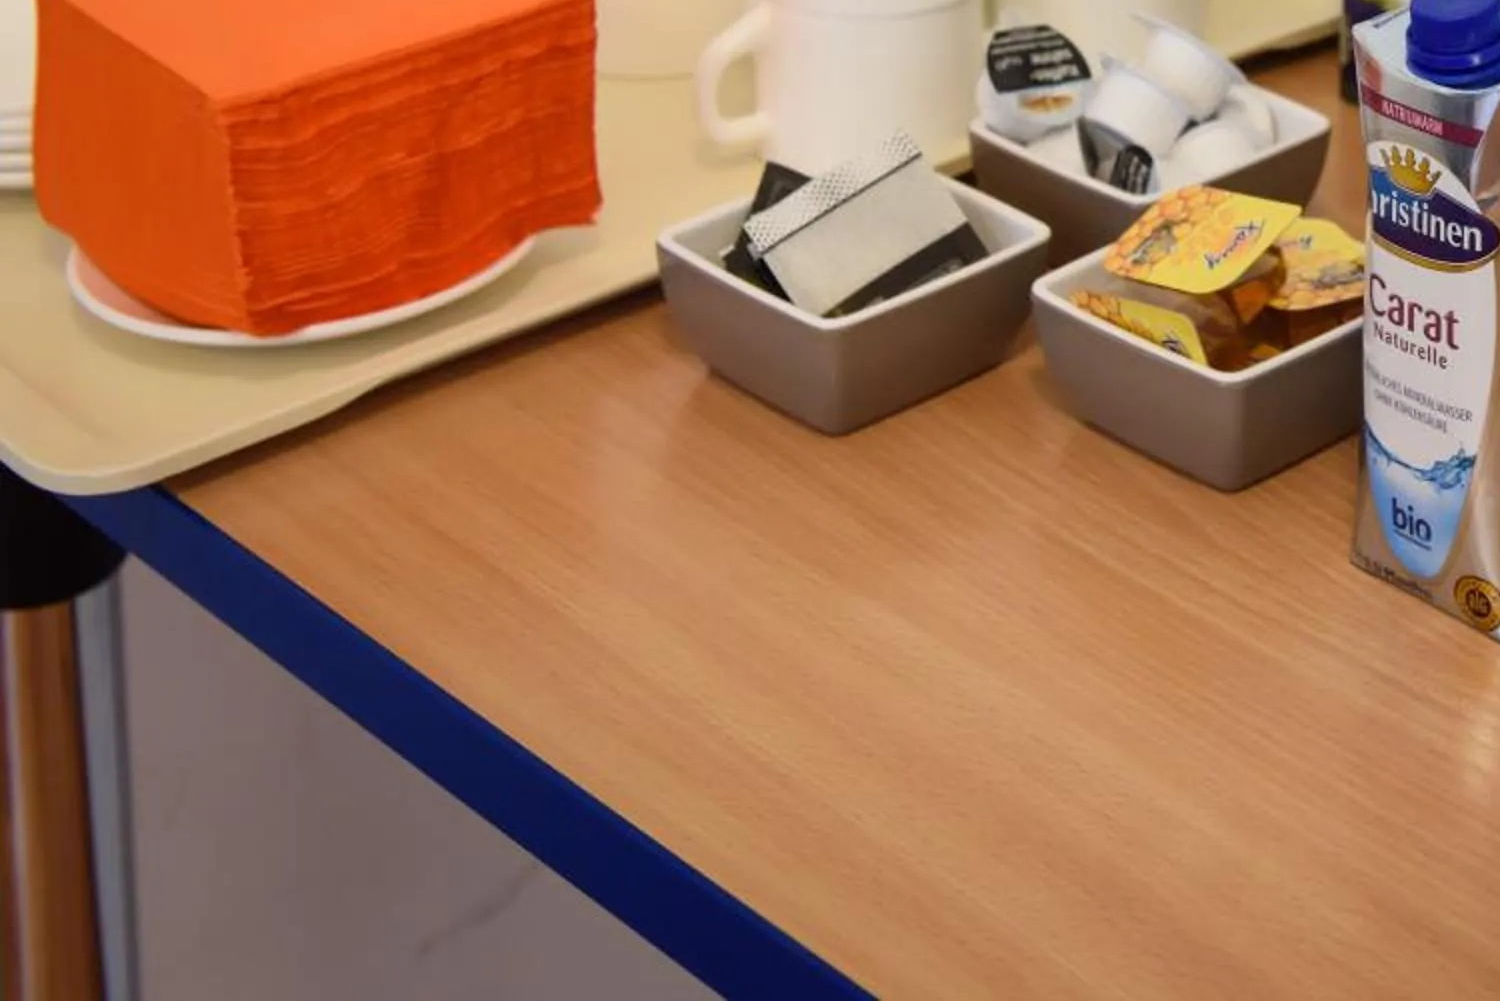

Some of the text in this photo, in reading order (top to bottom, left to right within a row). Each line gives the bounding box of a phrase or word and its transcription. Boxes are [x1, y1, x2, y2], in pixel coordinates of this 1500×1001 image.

[1369, 273, 1459, 350] Carat
[1373, 320, 1448, 369] Naturelle
[1391, 497, 1432, 543] bio
